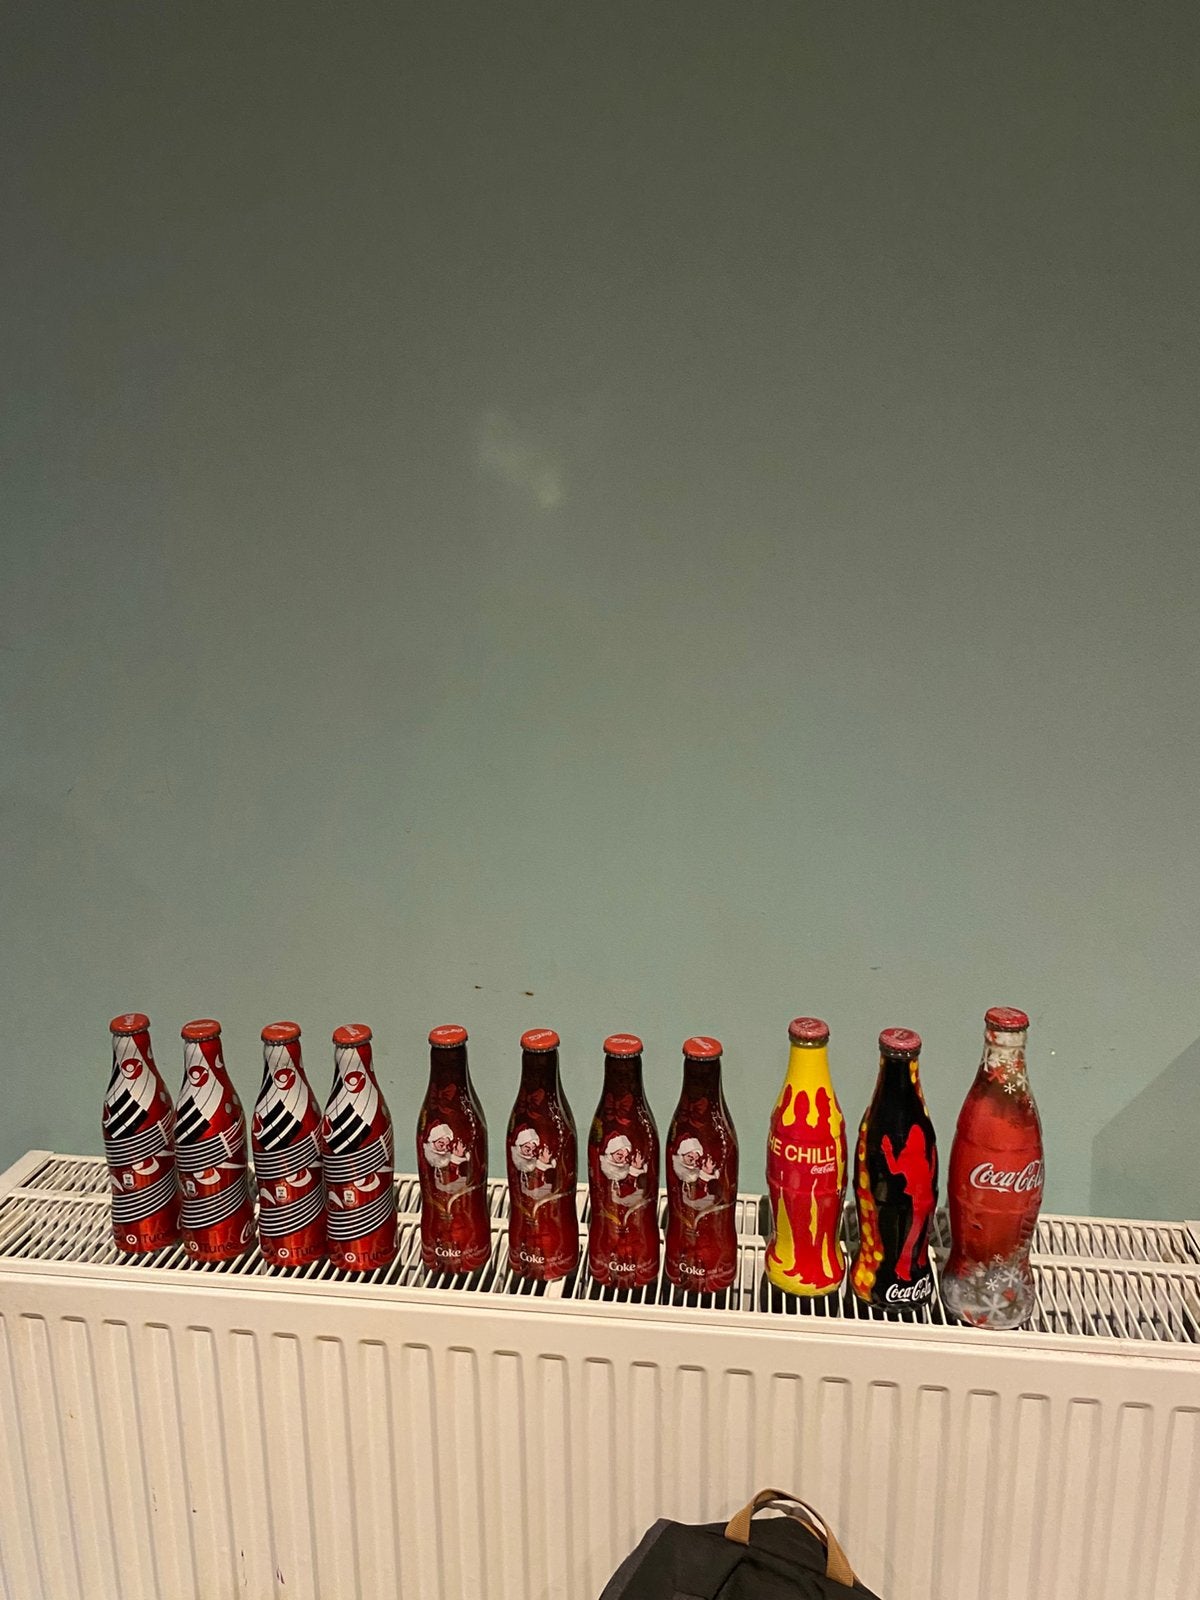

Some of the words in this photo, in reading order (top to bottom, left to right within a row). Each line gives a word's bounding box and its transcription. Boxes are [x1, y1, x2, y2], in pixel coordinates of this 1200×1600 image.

[767, 1129, 783, 1157] HE
[784, 1144, 835, 1164] CHILL
[435, 1246, 461, 1258] Coke
[520, 1251, 545, 1264] Coke
[609, 1261, 636, 1272] Coke
[679, 1262, 706, 1276] Coke
